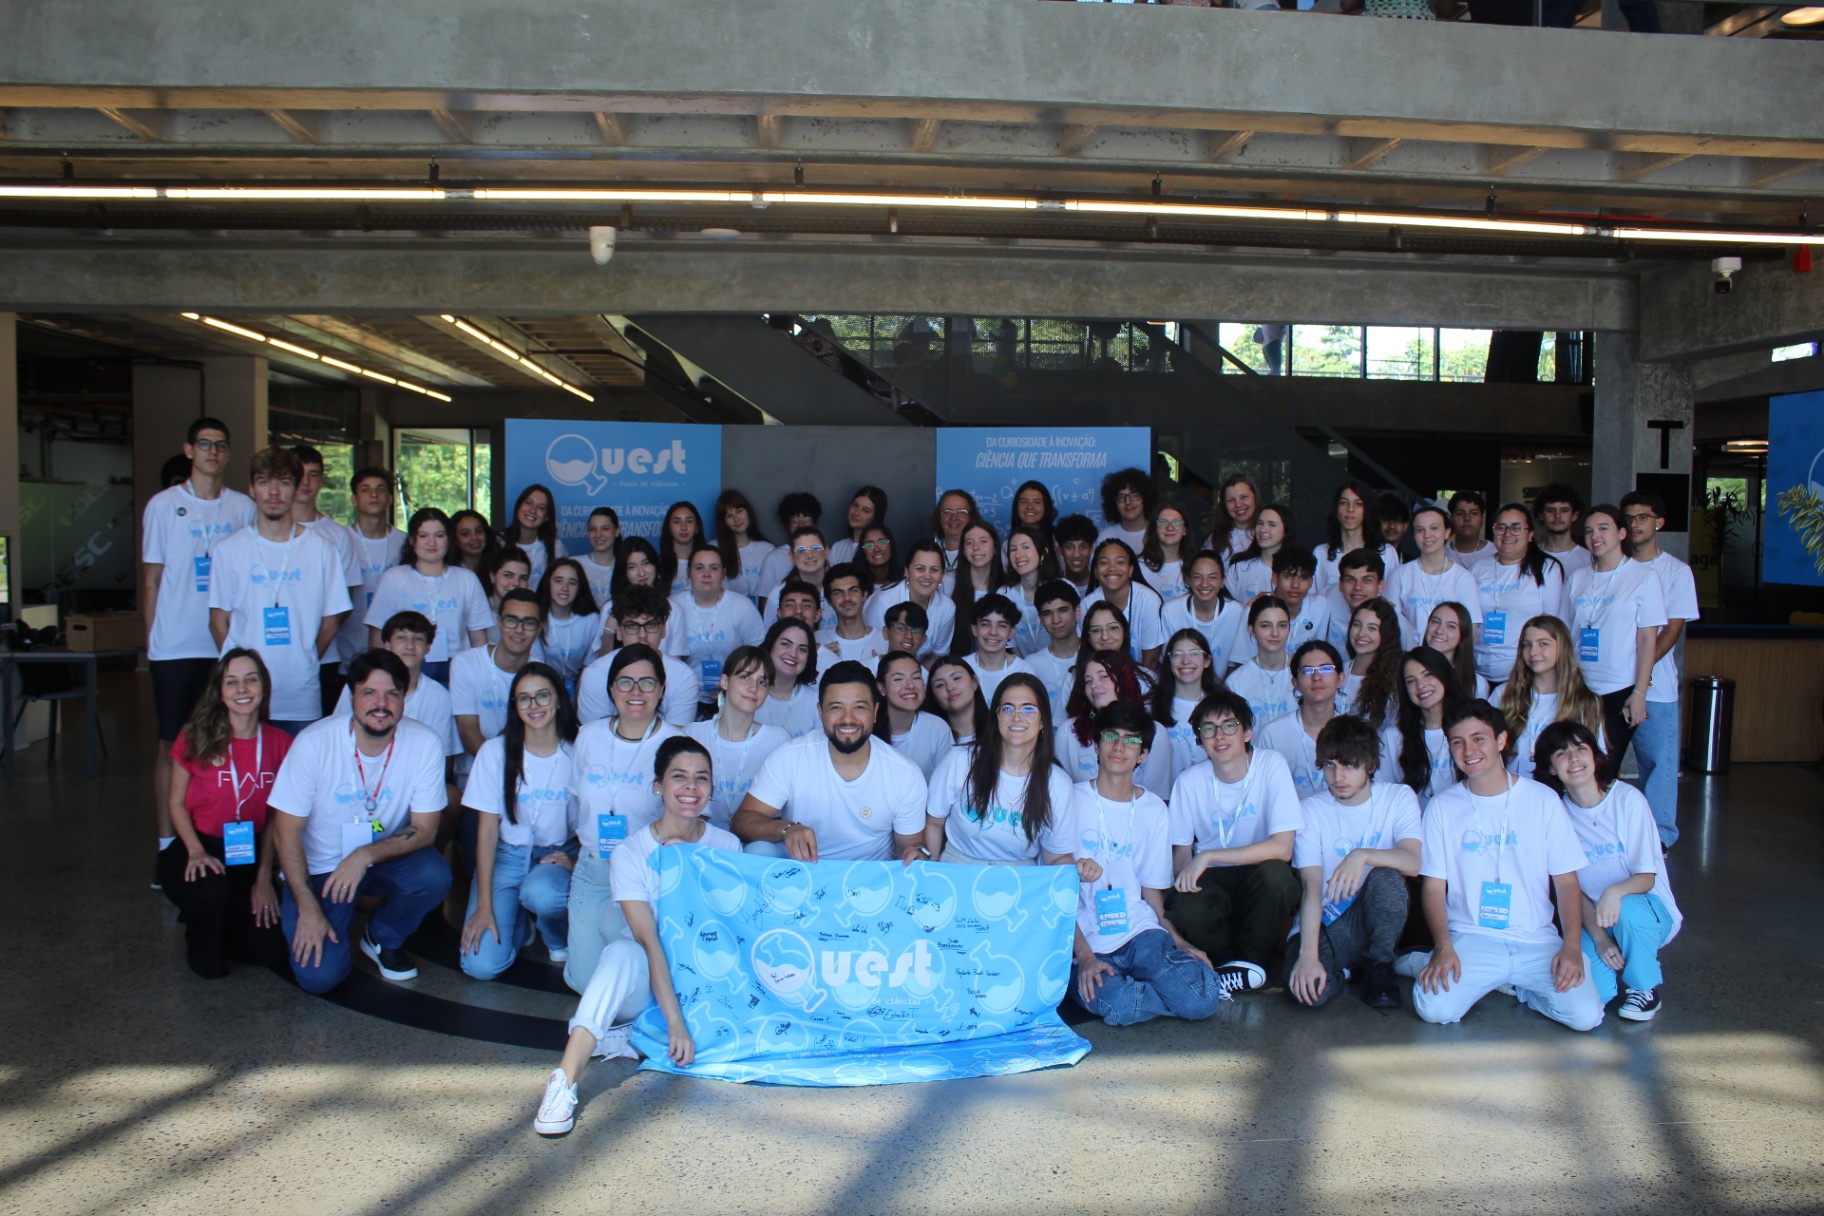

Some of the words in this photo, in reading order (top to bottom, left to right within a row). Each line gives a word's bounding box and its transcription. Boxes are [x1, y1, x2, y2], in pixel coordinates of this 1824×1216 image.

[986, 437, 998, 448] DA
[998, 437, 1047, 448] CURIOSIDADE
[1049, 434, 1055, 448] À
[1056, 434, 1096, 450] INOVAÇÃO:
[1647, 420, 1684, 469] T
[975, 449, 1015, 469] CIÊNCIA
[1017, 452, 1039, 470] QUE
[1040, 452, 1107, 469] TRANSFORMA
[561, 505, 572, 517] DA
[625, 502, 631, 516] À
[871, 996, 882, 1005] de
[885, 996, 921, 1005] ciências
